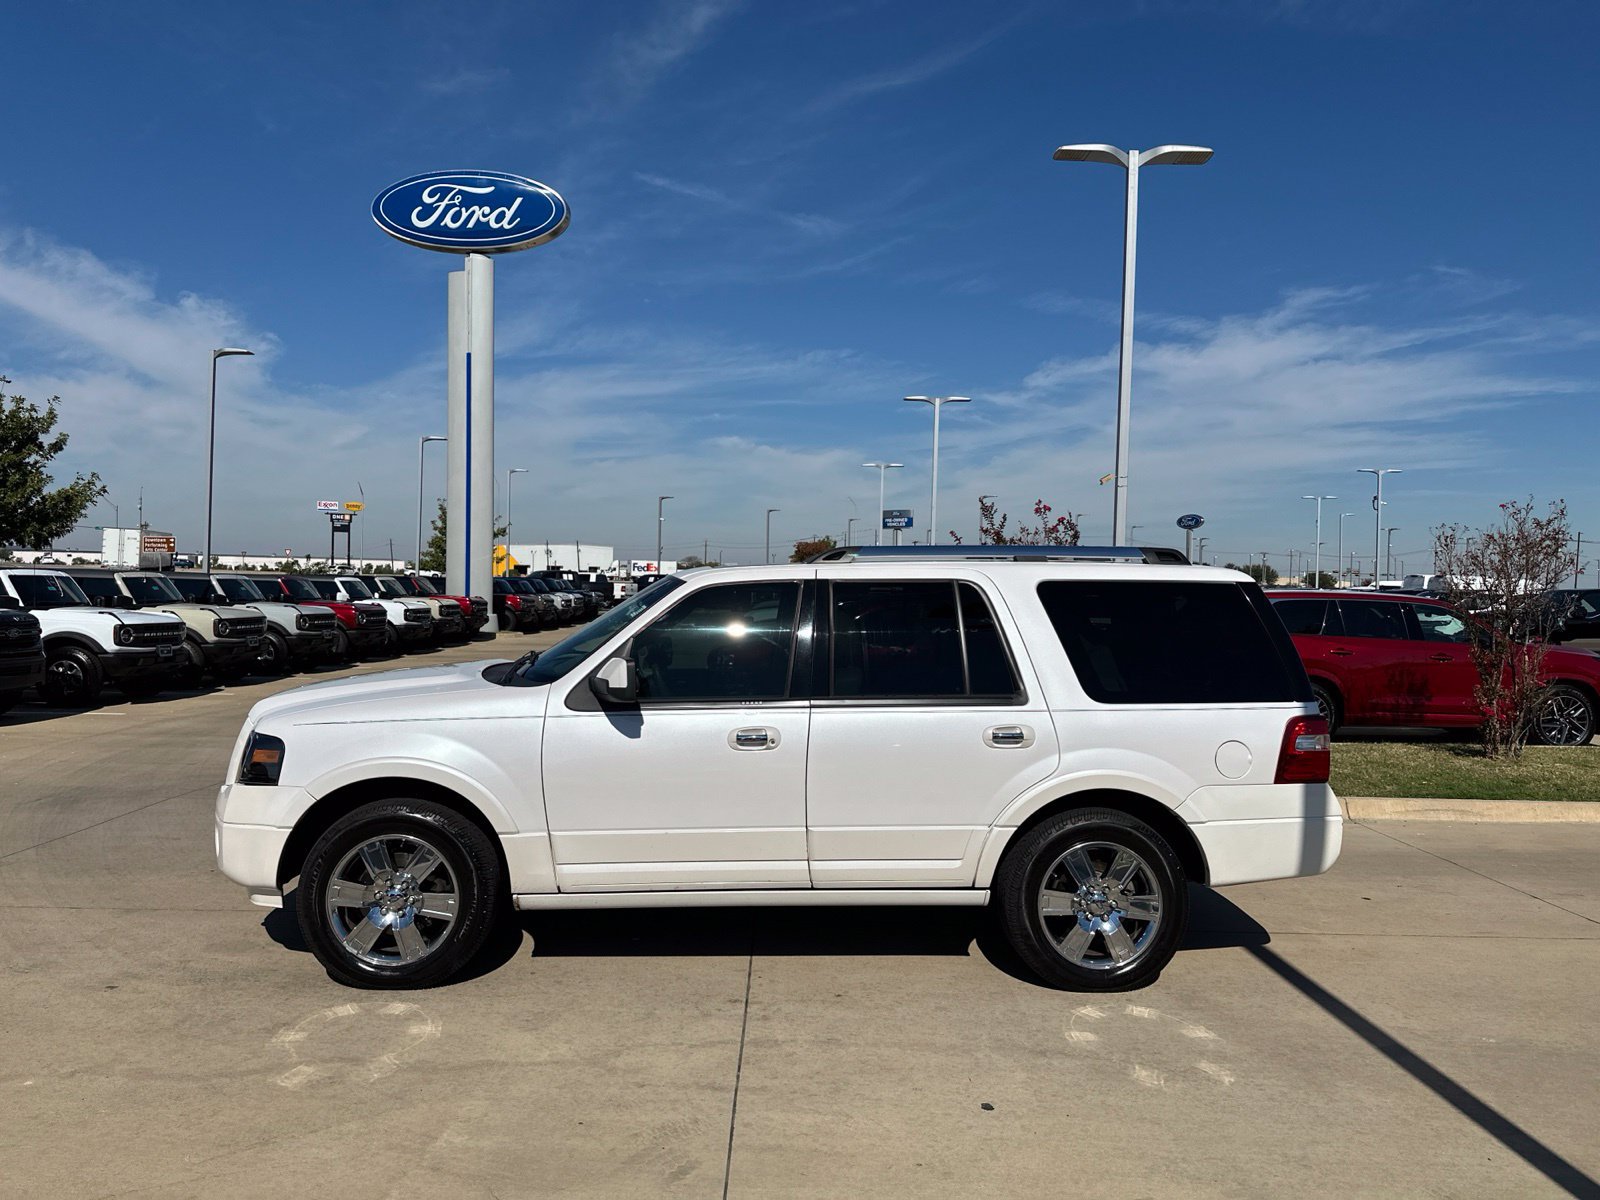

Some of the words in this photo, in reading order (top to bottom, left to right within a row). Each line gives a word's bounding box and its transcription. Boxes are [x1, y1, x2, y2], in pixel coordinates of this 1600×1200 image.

[410, 183, 523, 228] Ford
[1181, 517, 1197, 526] Ford
[632, 562, 660, 572] FedEx
